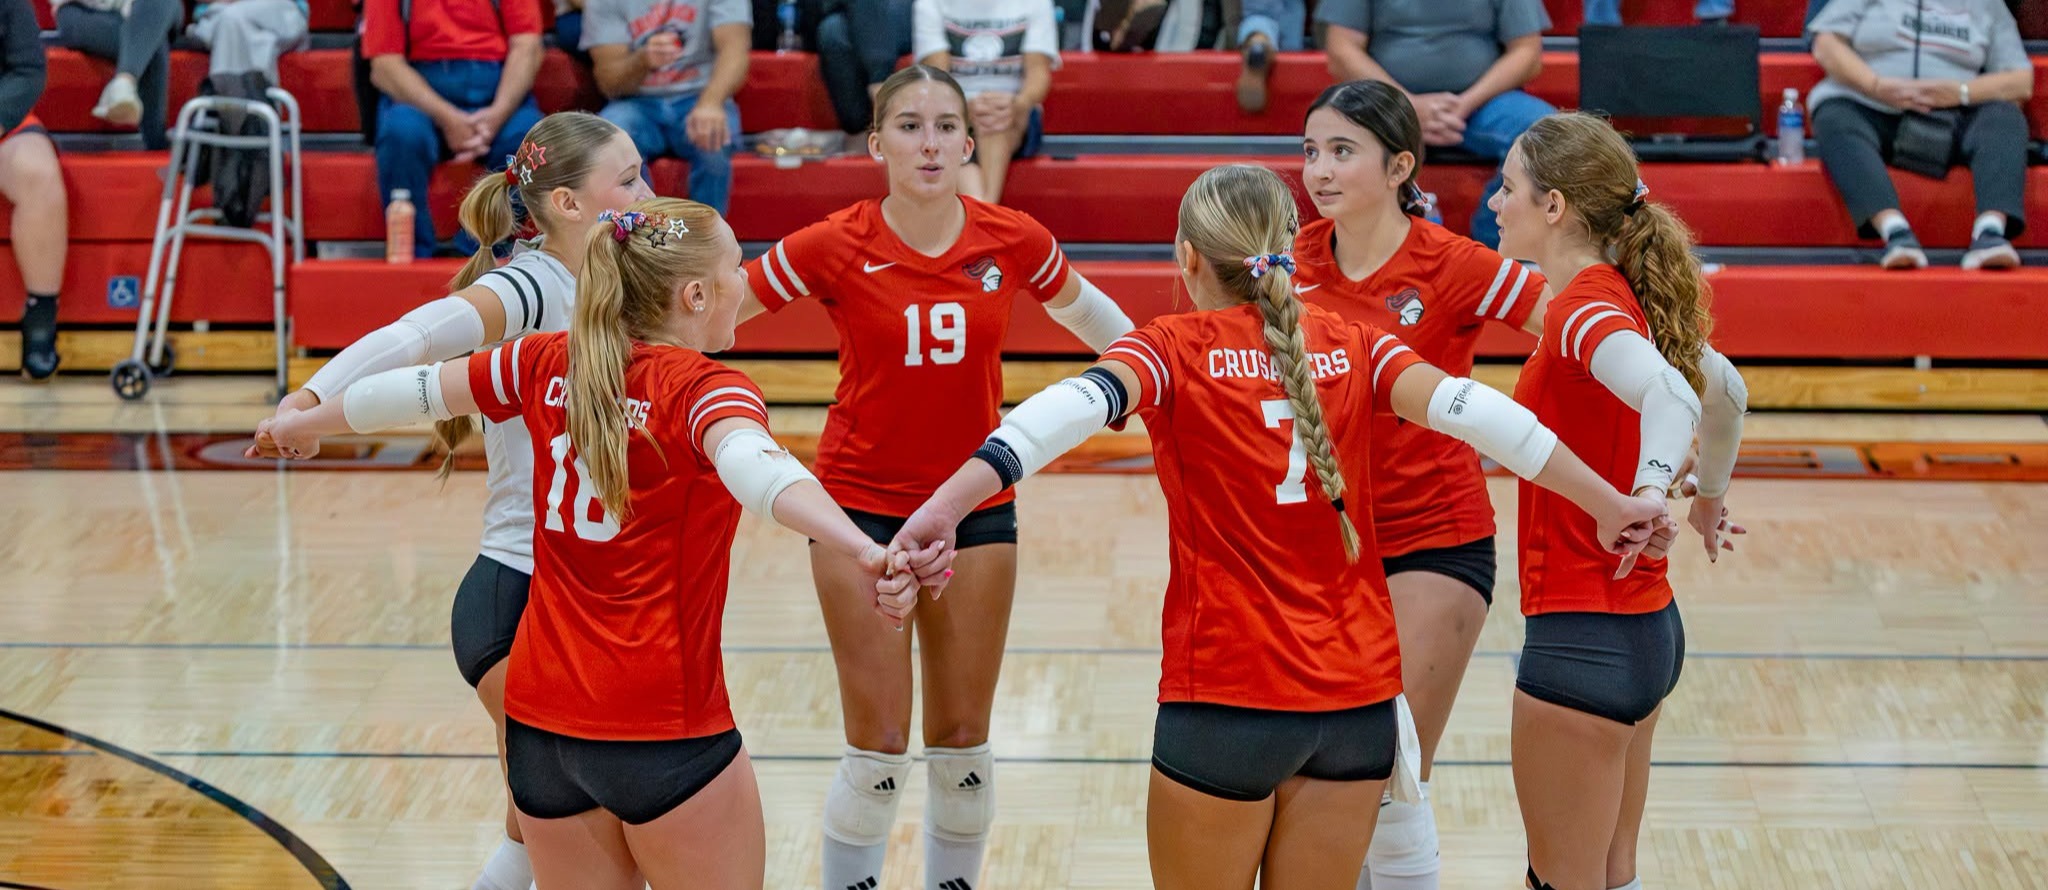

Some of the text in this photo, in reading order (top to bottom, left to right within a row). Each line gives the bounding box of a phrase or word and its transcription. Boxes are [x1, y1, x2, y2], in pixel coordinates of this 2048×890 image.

[903, 302, 967, 367] 19
[1208, 348, 1351, 382] CRUSAERS
[1260, 399, 1309, 505] 7
